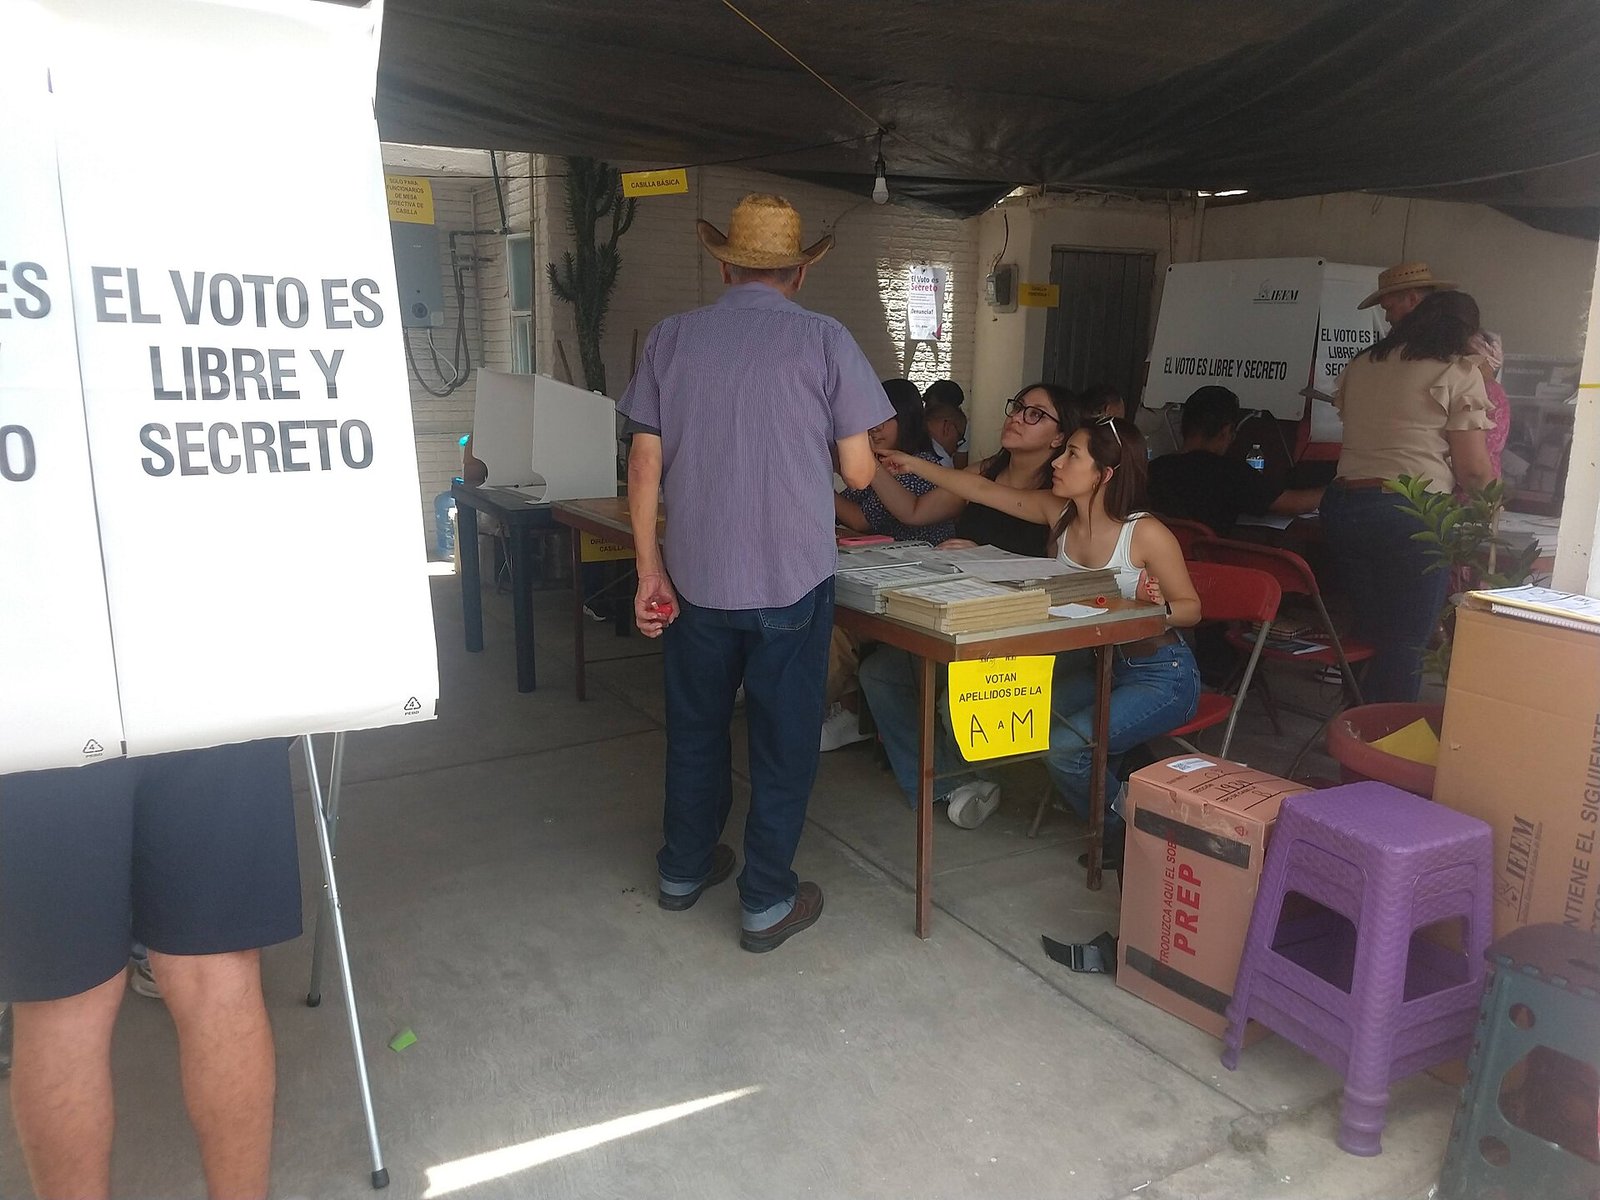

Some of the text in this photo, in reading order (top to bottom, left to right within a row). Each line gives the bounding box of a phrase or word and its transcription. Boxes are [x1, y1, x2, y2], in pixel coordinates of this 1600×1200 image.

[91, 266, 385, 330] EL VOTO ES
[911, 283, 938, 292] Secreto
[1320, 328, 1332, 341] EL
[1333, 328, 1357, 343] VOTO
[1358, 330, 1371, 343] ES
[1328, 346, 1354, 359] LIBRE
[148, 346, 345, 401] LIBRE Y
[1163, 357, 1288, 381] EL VOTO ES LIBRE Y SECRETO
[138, 419, 375, 477] SECRETO
[958, 685, 1042, 703] APELLIDOS DE LA
[985, 672, 1017, 684] VOTAN
[970, 714, 989, 748] A
[1011, 709, 1033, 742] M
[1505, 814, 1535, 881] IEEM
[1575, 830, 1596, 854] EL
[1159, 836, 1177, 964] TRODUZCA AQUÍ EL SOB
[1173, 863, 1202, 957] PREP
[1563, 856, 1591, 929] NTIENE
